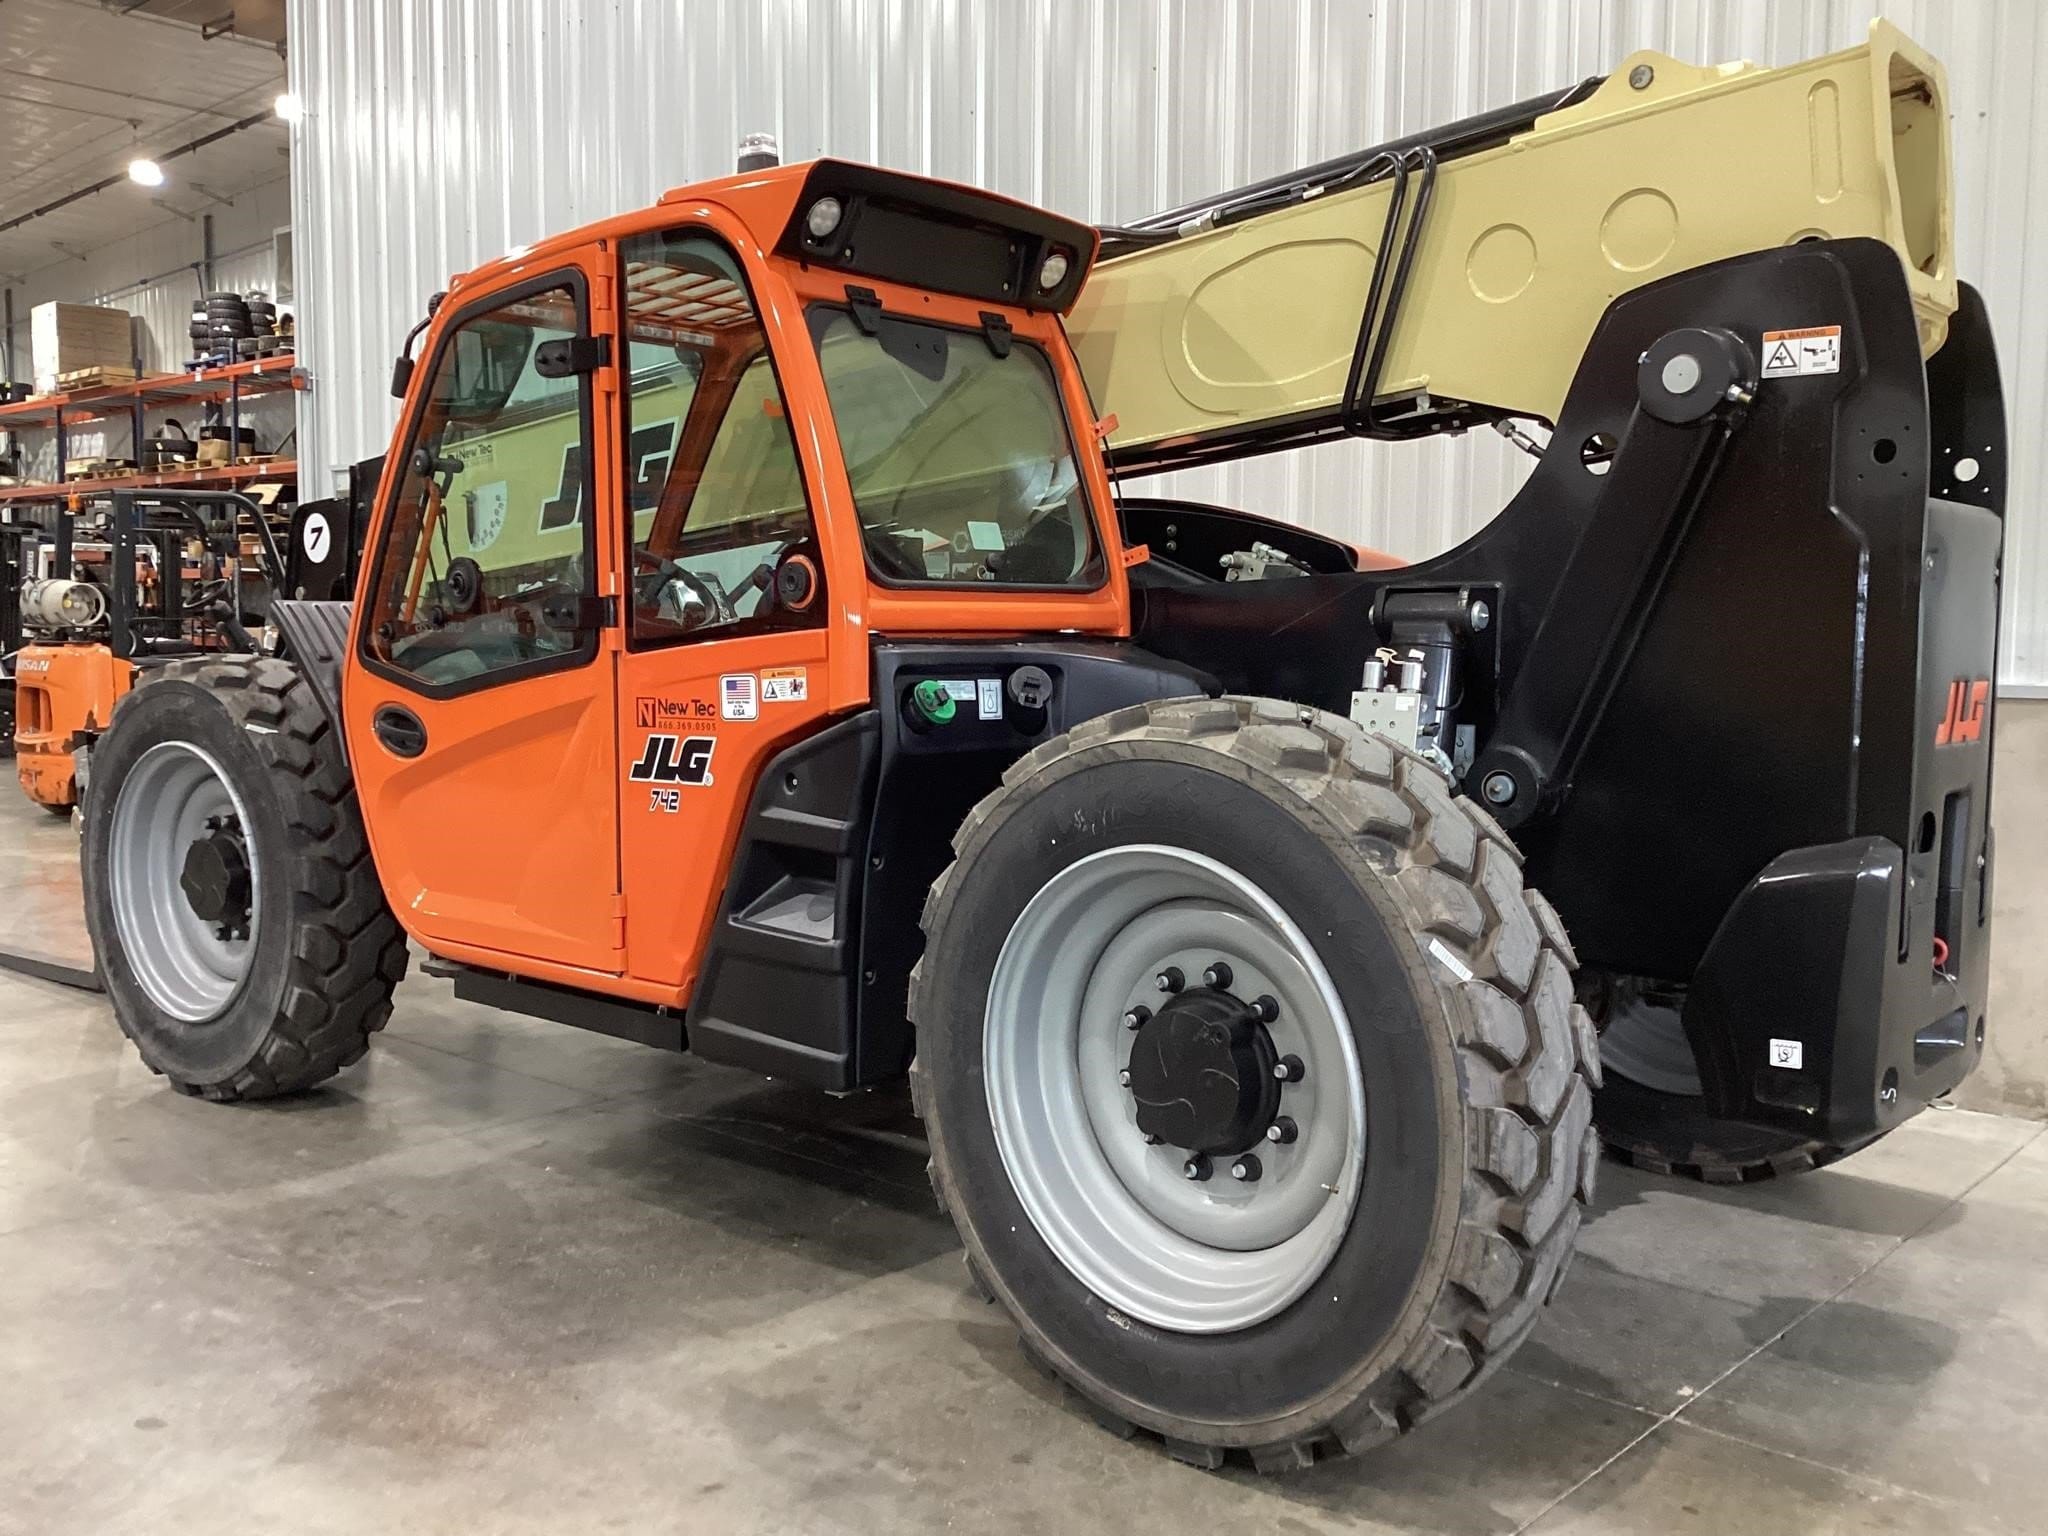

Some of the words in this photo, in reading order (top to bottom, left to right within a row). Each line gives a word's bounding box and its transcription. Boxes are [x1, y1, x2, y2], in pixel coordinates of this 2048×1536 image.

[310, 526, 323, 551] 7
[657, 698, 688, 716] New
[691, 698, 716, 717] Tec
[733, 708, 745, 716] USA
[1935, 680, 1989, 746] JLG
[630, 735, 716, 785] JLG
[649, 788, 681, 813] 742
